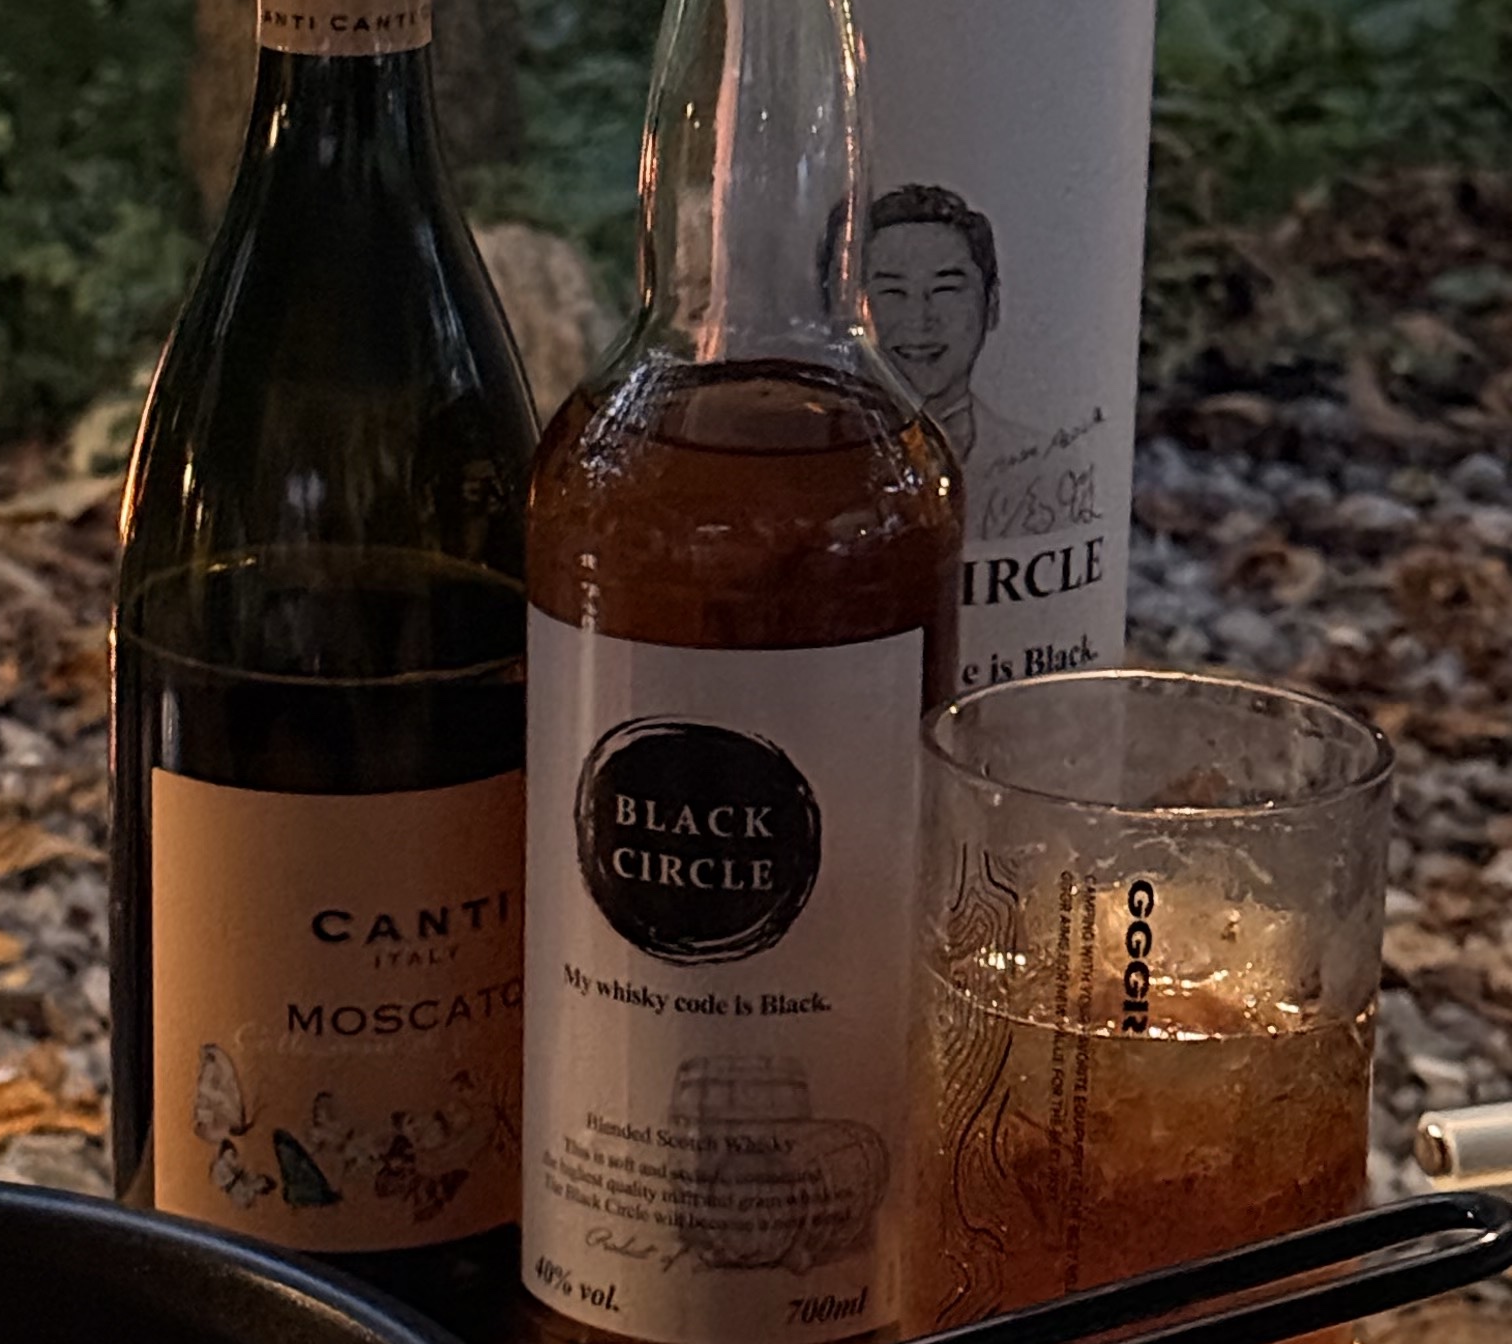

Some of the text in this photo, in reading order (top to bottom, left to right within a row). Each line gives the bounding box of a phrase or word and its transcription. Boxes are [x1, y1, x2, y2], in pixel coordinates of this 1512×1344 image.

[261, 9, 315, 31] ANTI
[330, 10, 416, 32] CANTI
[961, 536, 1105, 606] IRCLE
[990, 653, 1014, 684] is
[615, 793, 774, 838] BLACK
[612, 847, 774, 891] CIRCLE
[311, 890, 509, 946] CANTI
[374, 945, 459, 969] ITALY
[287, 976, 523, 1037] MOSCATO
[563, 963, 833, 1016] My whisky code is Black.
[587, 1112, 652, 1144] Blended
[638, 1158, 667, 1180] and
[606, 1176, 657, 1205] quality
[604, 1198, 649, 1223] Circle
[534, 1256, 621, 1313] 40% vol.
[789, 1286, 870, 1325] 700ml
